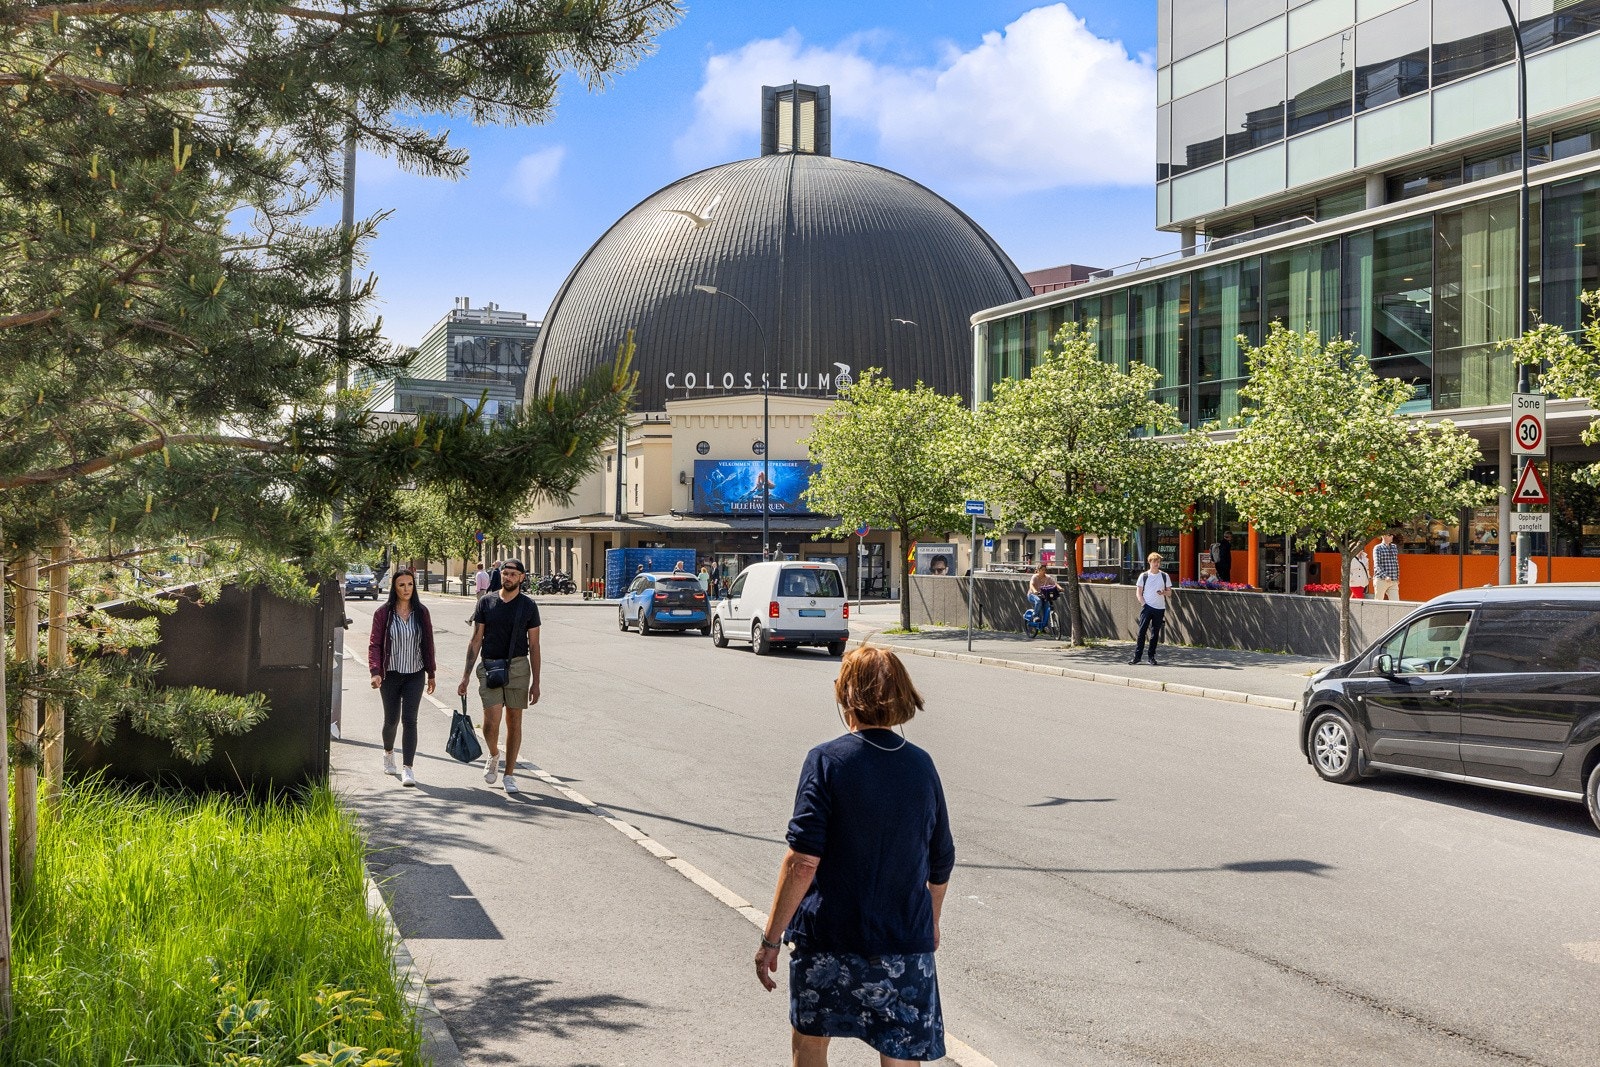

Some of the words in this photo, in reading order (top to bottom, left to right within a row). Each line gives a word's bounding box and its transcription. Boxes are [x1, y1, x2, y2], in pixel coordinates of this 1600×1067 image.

[665, 372, 829, 390] COLOSSEUM
[1518, 397, 1540, 409] Sone
[1521, 424, 1537, 441] 30
[731, 502, 748, 510] LILLE
[749, 502, 785, 512] HAVRUEN
[1518, 514, 1542, 522] Opphøyd
